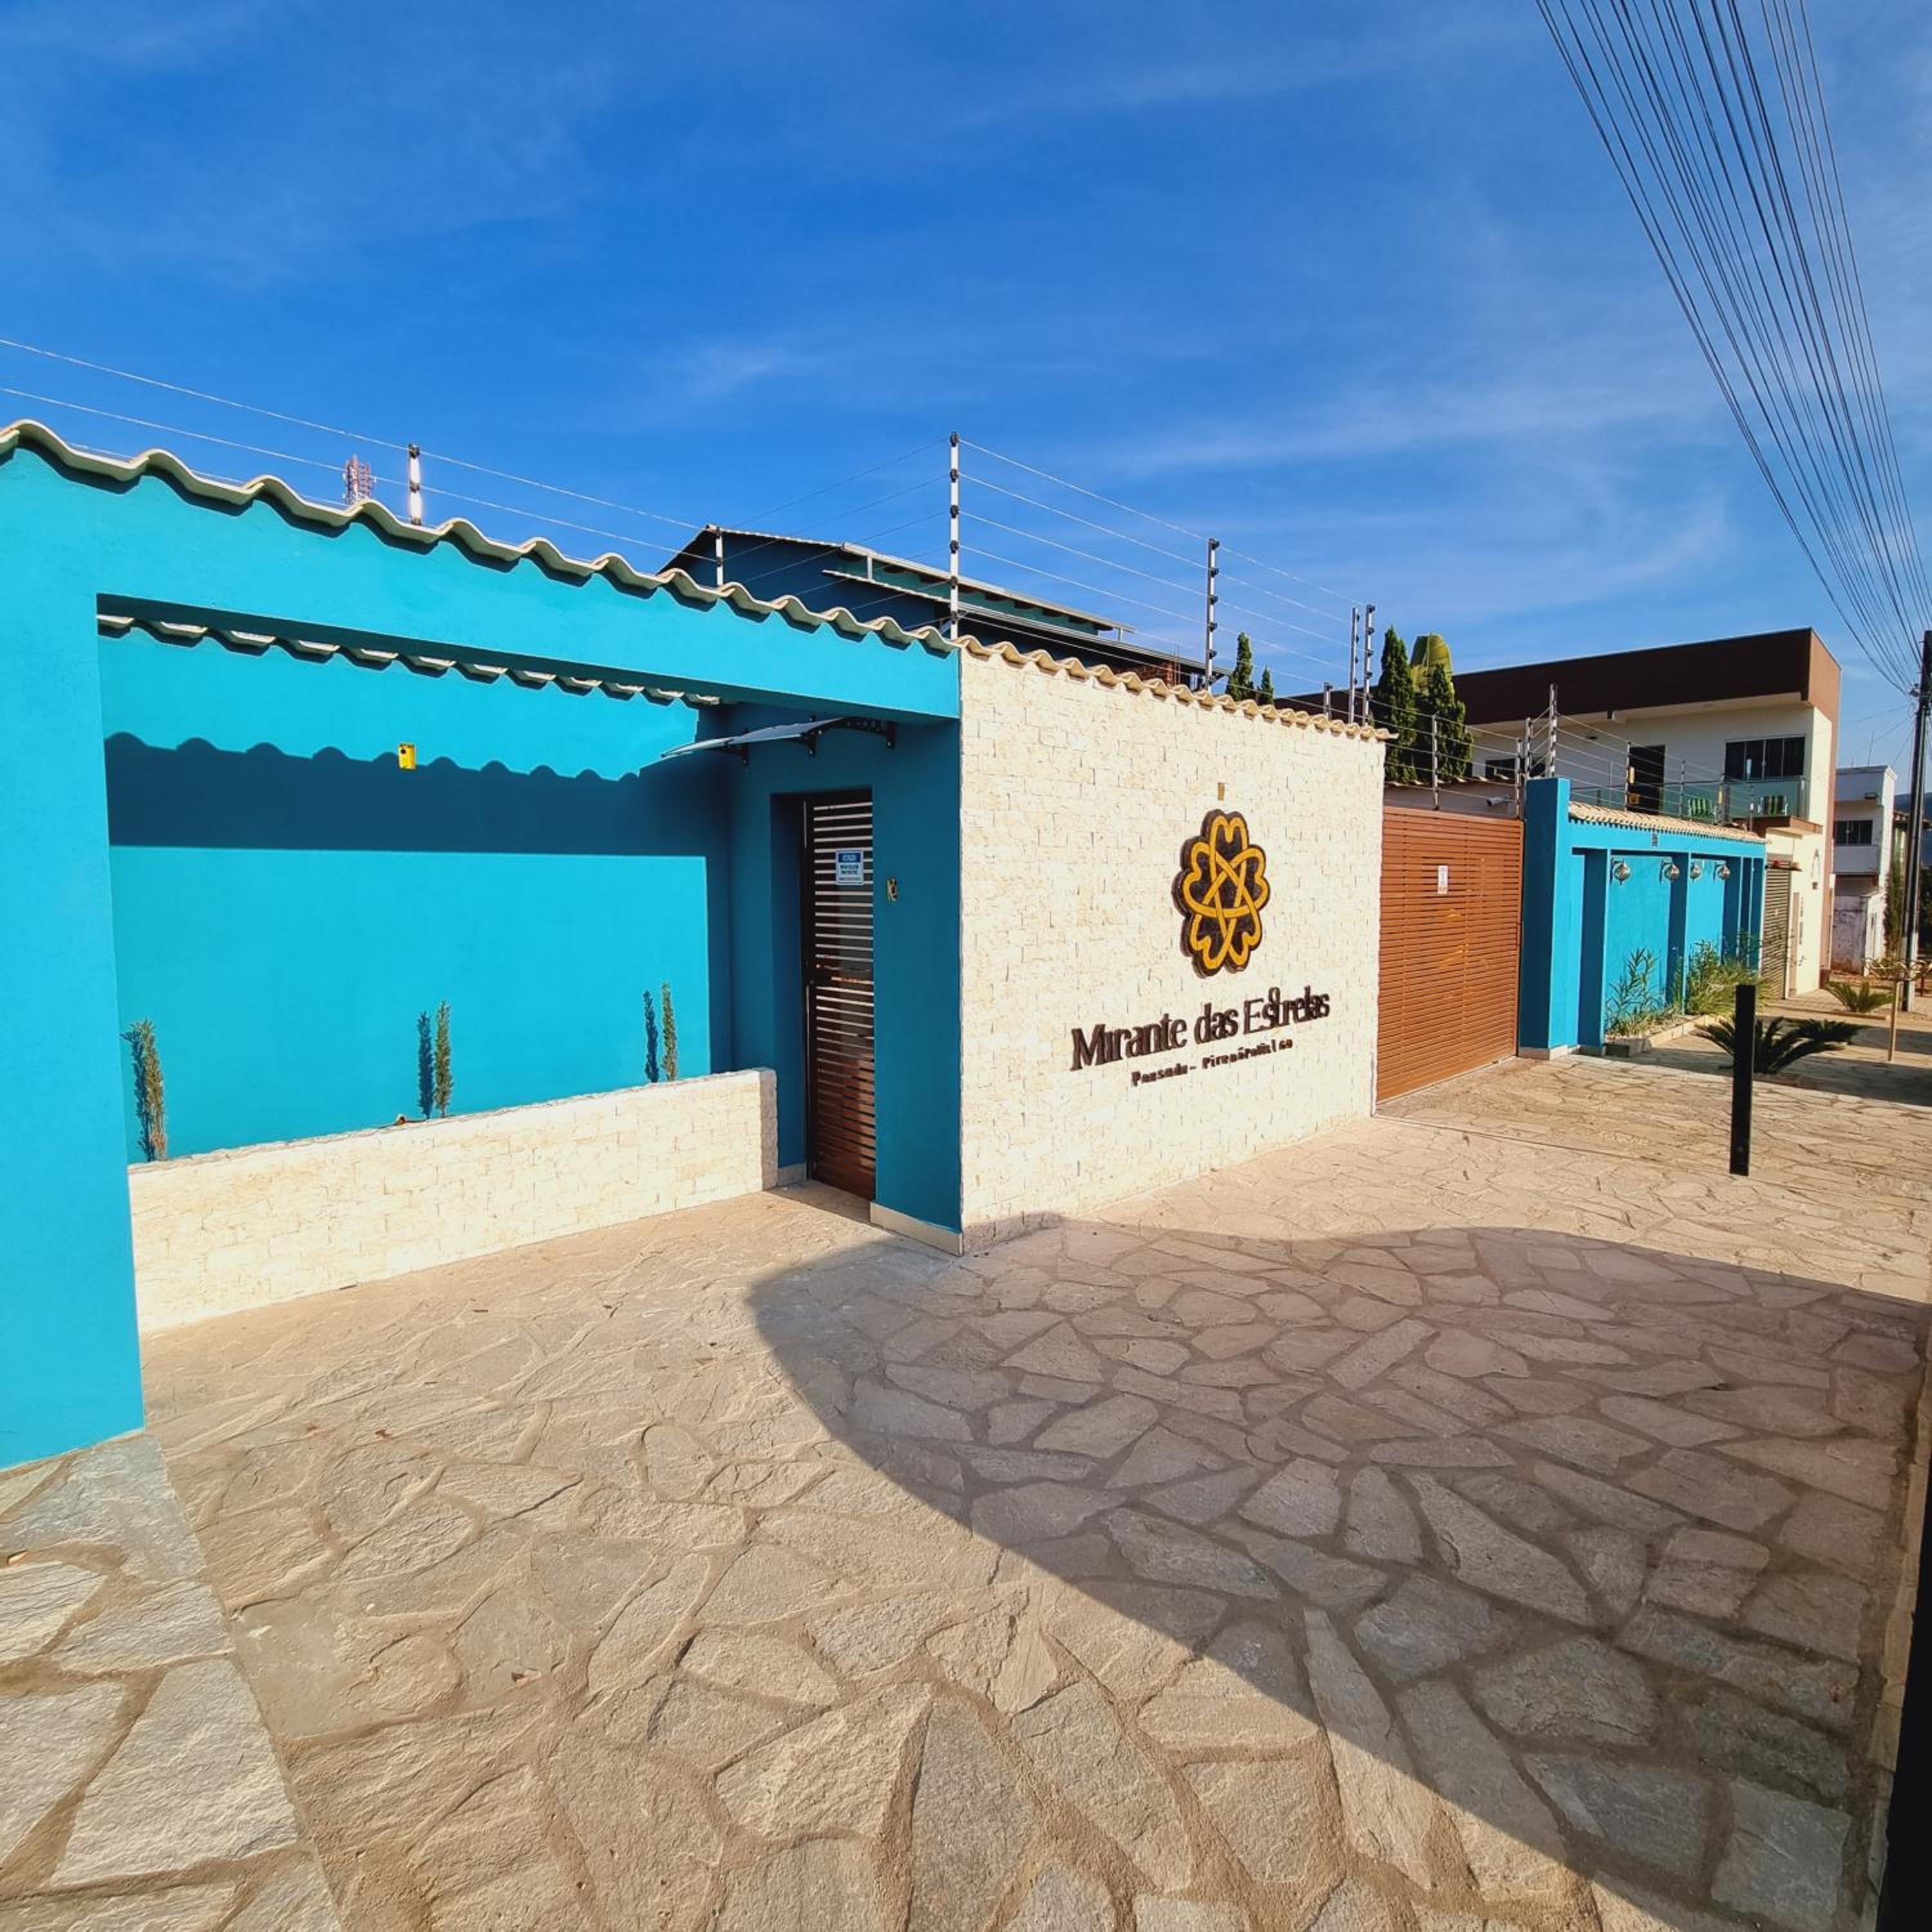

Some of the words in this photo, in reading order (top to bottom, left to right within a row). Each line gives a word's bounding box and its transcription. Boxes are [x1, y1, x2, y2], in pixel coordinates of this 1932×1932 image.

[1070, 1013, 1188, 1072] Mirante
[1194, 1002, 1238, 1045] das
[1243, 985, 1330, 1034] Estrelas
